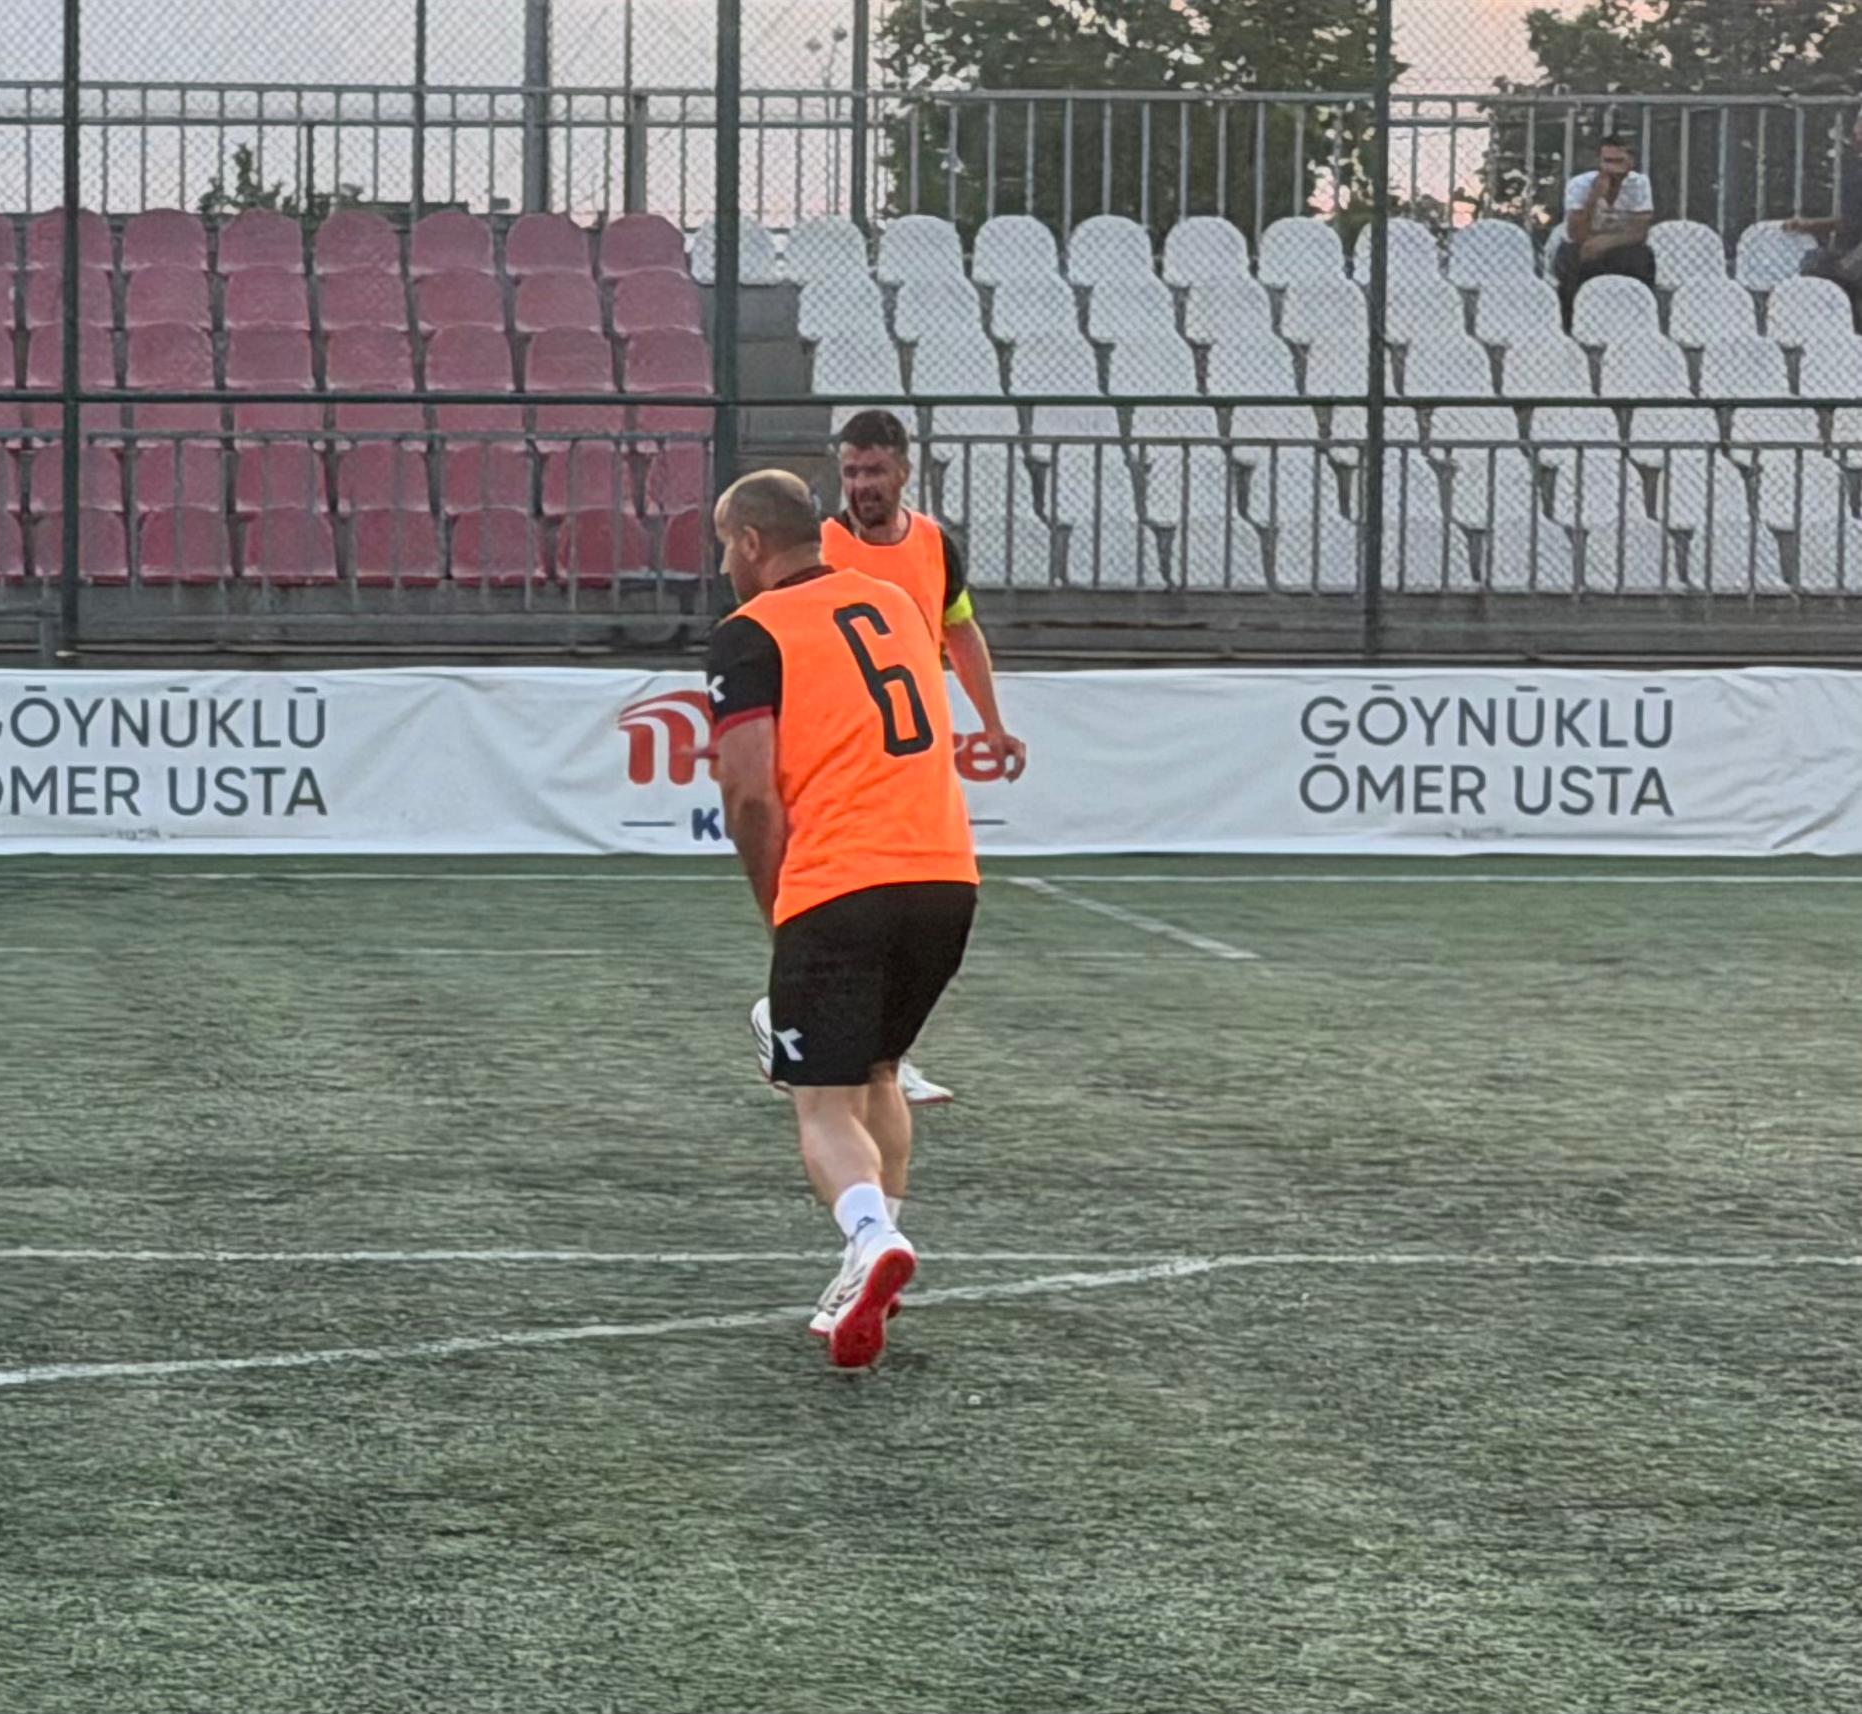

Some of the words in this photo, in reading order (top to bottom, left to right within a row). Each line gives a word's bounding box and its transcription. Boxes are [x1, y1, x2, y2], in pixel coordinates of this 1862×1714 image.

[833, 602, 934, 757] 6
[167, 766, 328, 816] USTA
[1514, 765, 1674, 817] USTA
